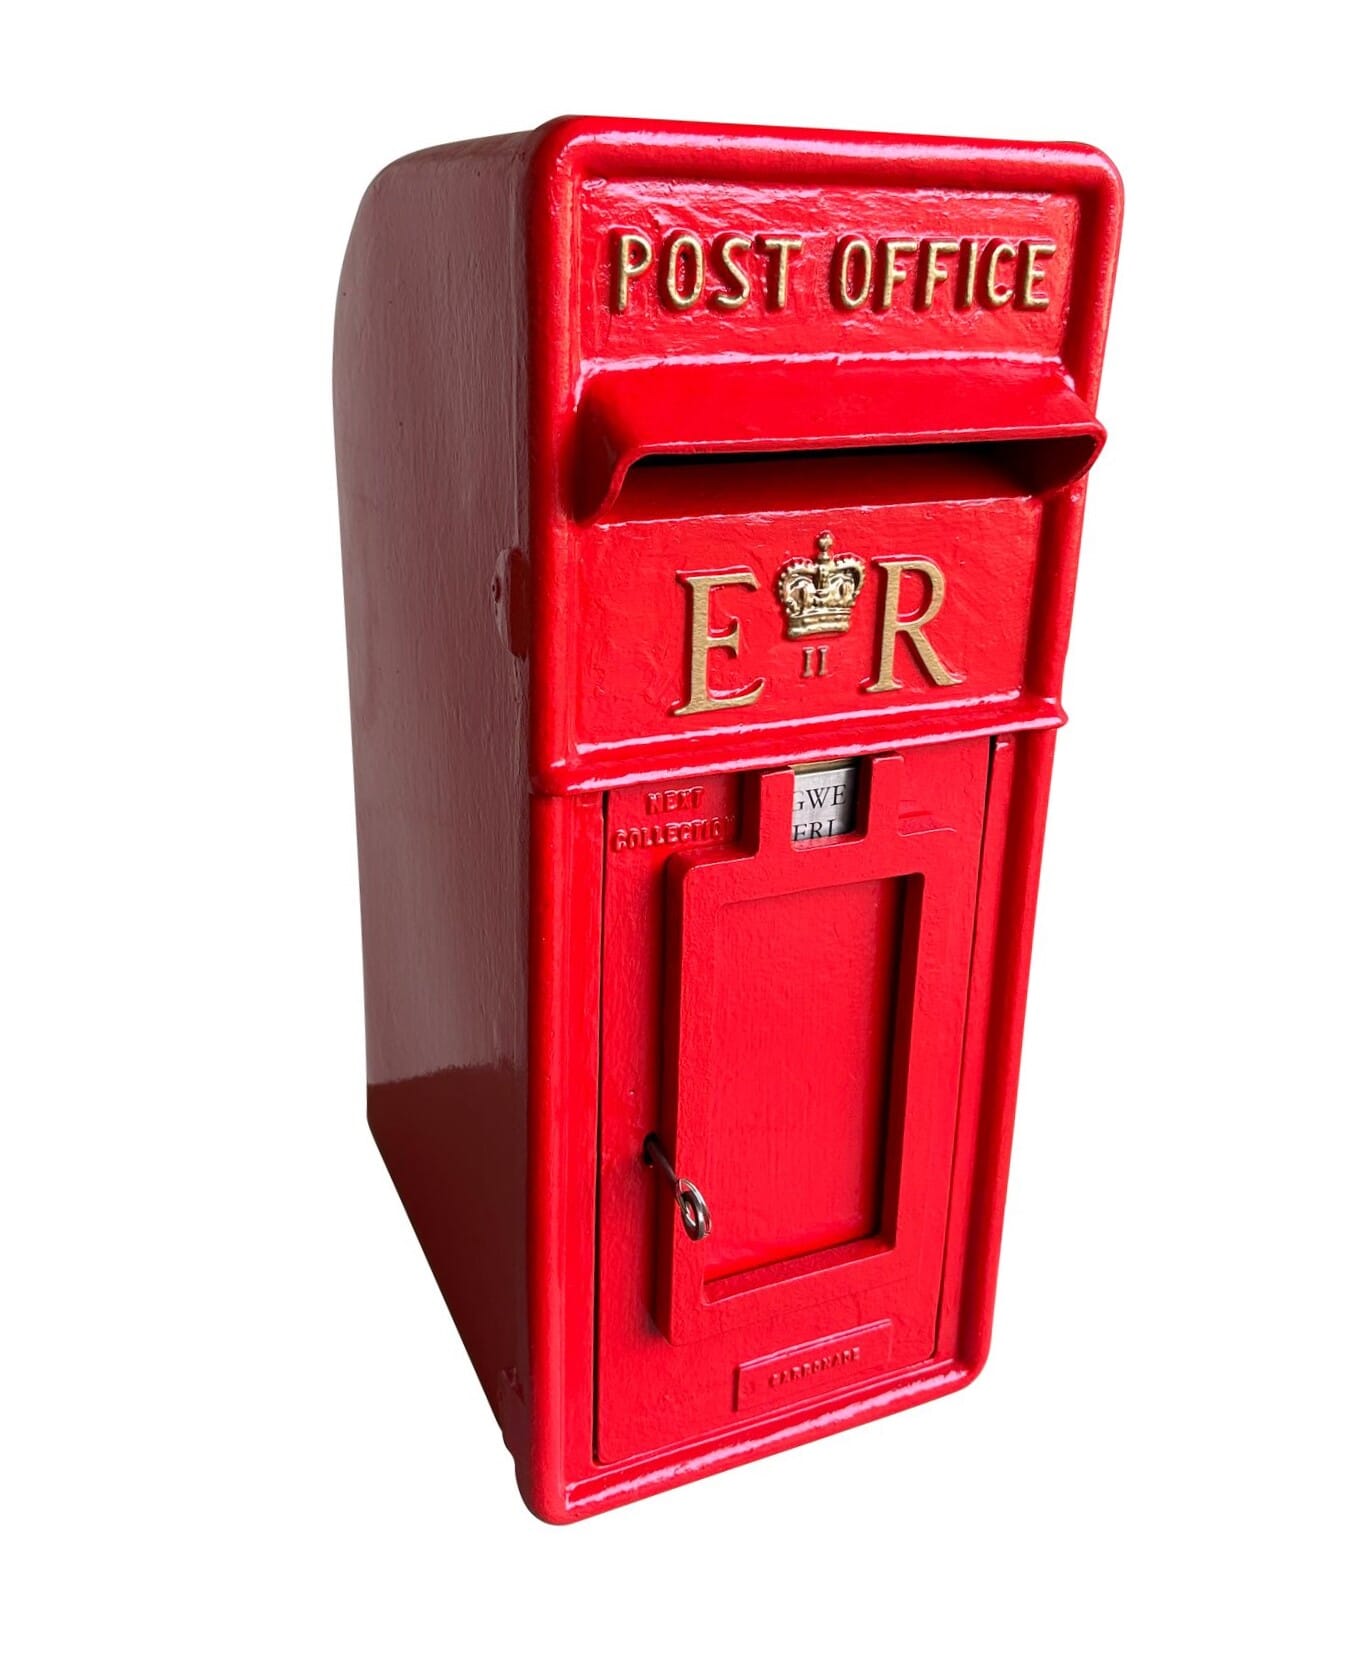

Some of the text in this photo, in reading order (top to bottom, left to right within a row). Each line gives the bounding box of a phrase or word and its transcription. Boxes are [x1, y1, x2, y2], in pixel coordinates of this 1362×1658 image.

[614, 232, 1057, 311] POST OFFICE
[673, 556, 967, 717] E II R
[646, 785, 704, 815] NEXT
